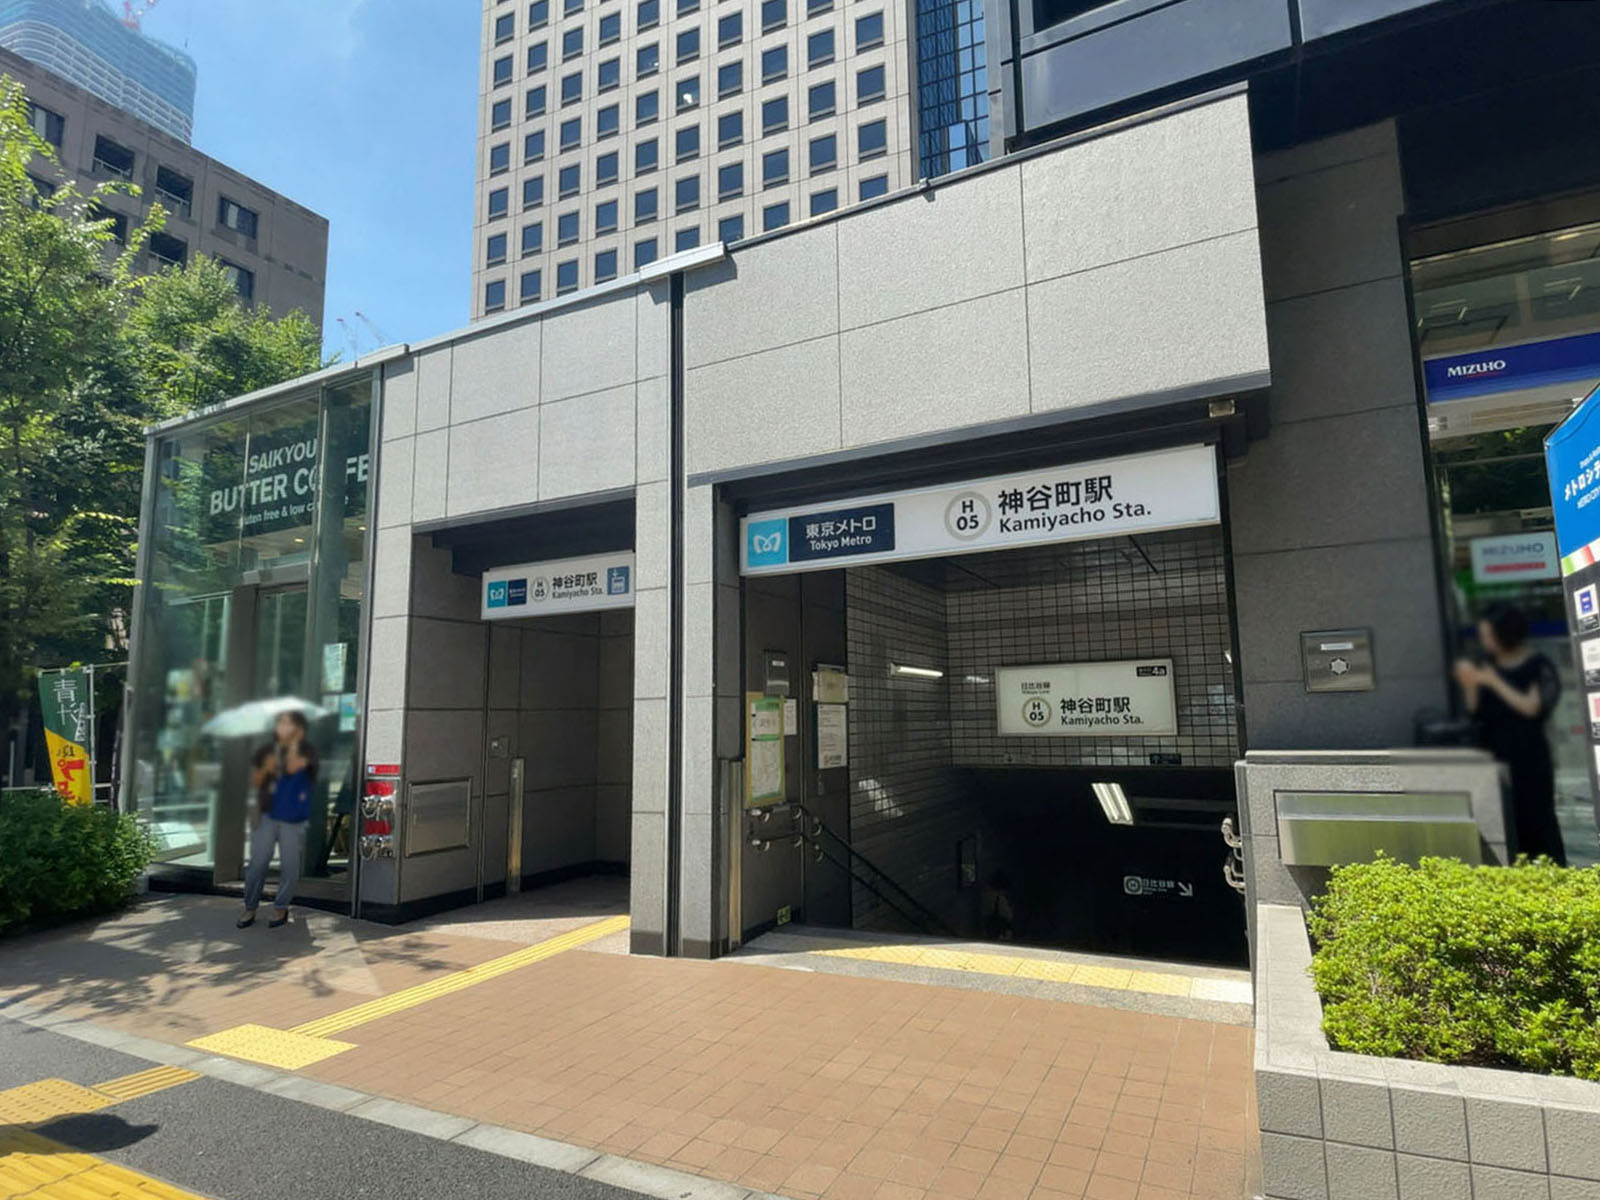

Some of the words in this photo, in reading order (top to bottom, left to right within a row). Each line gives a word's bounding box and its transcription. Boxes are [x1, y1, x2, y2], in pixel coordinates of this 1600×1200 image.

[1447, 360, 1506, 377] MIZUHO
[249, 438, 318, 474] SAIKYOU
[210, 473, 288, 515] BUTTER
[998, 475, 1113, 515] 神谷町駅
[962, 500, 974, 513] H
[956, 515, 979, 531] 05
[1000, 507, 1105, 533] Kamiyacho
[1113, 502, 1151, 519] Sta.
[805, 516, 876, 539] 東京メトロ
[810, 537, 839, 552] Tokyo
[841, 535, 872, 548] Metro
[552, 572, 598, 589] 神谷町駅
[534, 588, 545, 597] 05
[552, 587, 589, 600] Kamiyacho
[1032, 702, 1041, 711] H
[1060, 697, 1131, 714] 神谷町駅
[1029, 712, 1045, 721] 05
[1061, 715, 1120, 728] Kamiyacho
[1123, 715, 1144, 725] Sta.
